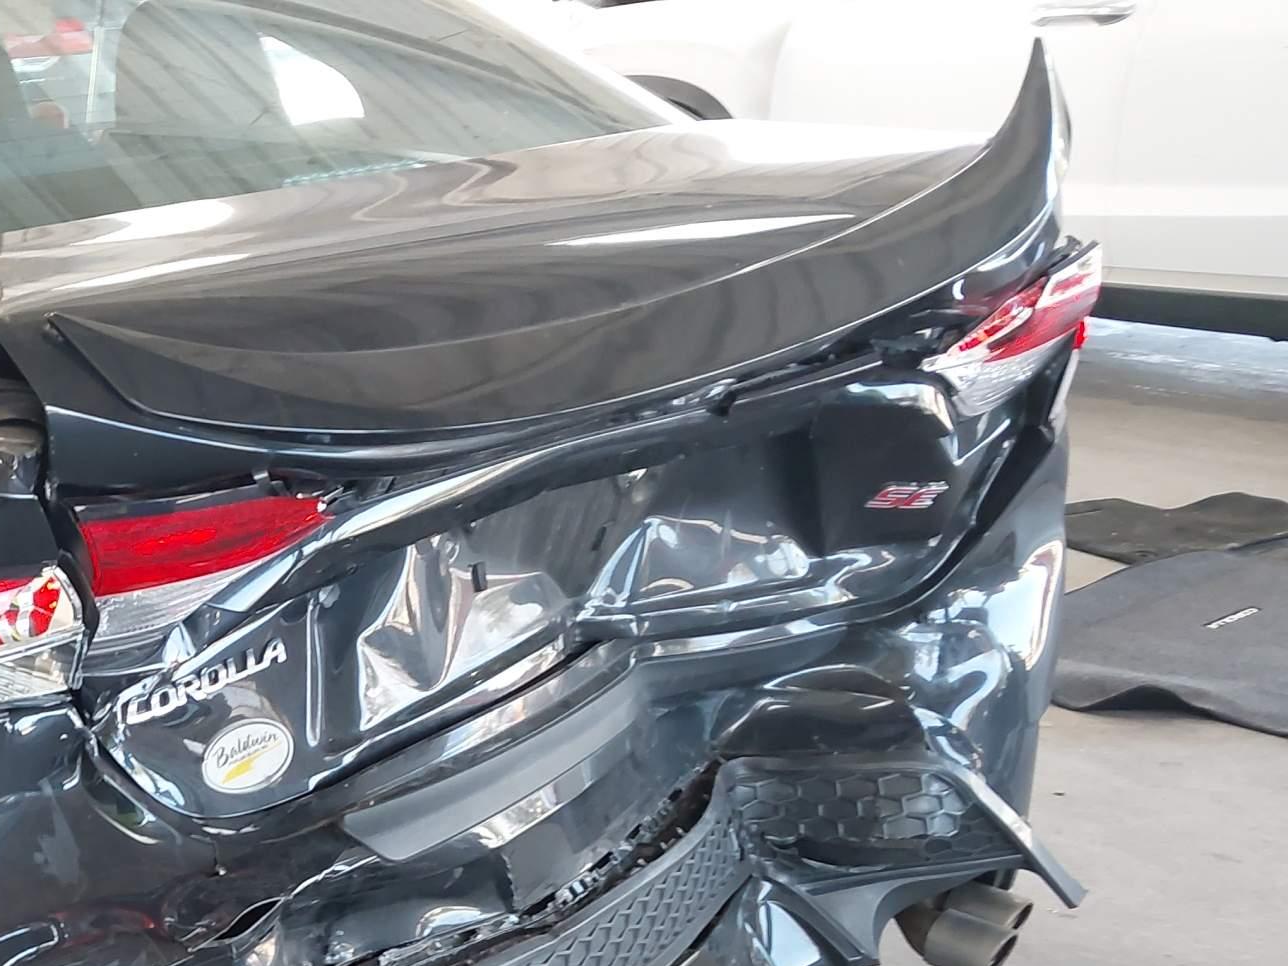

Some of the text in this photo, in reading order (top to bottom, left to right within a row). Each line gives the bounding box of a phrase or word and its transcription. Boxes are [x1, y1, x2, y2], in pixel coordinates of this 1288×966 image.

[864, 481, 949, 508] SE
[126, 638, 287, 725] COROLLA
[213, 732, 280, 769] Baldwin
